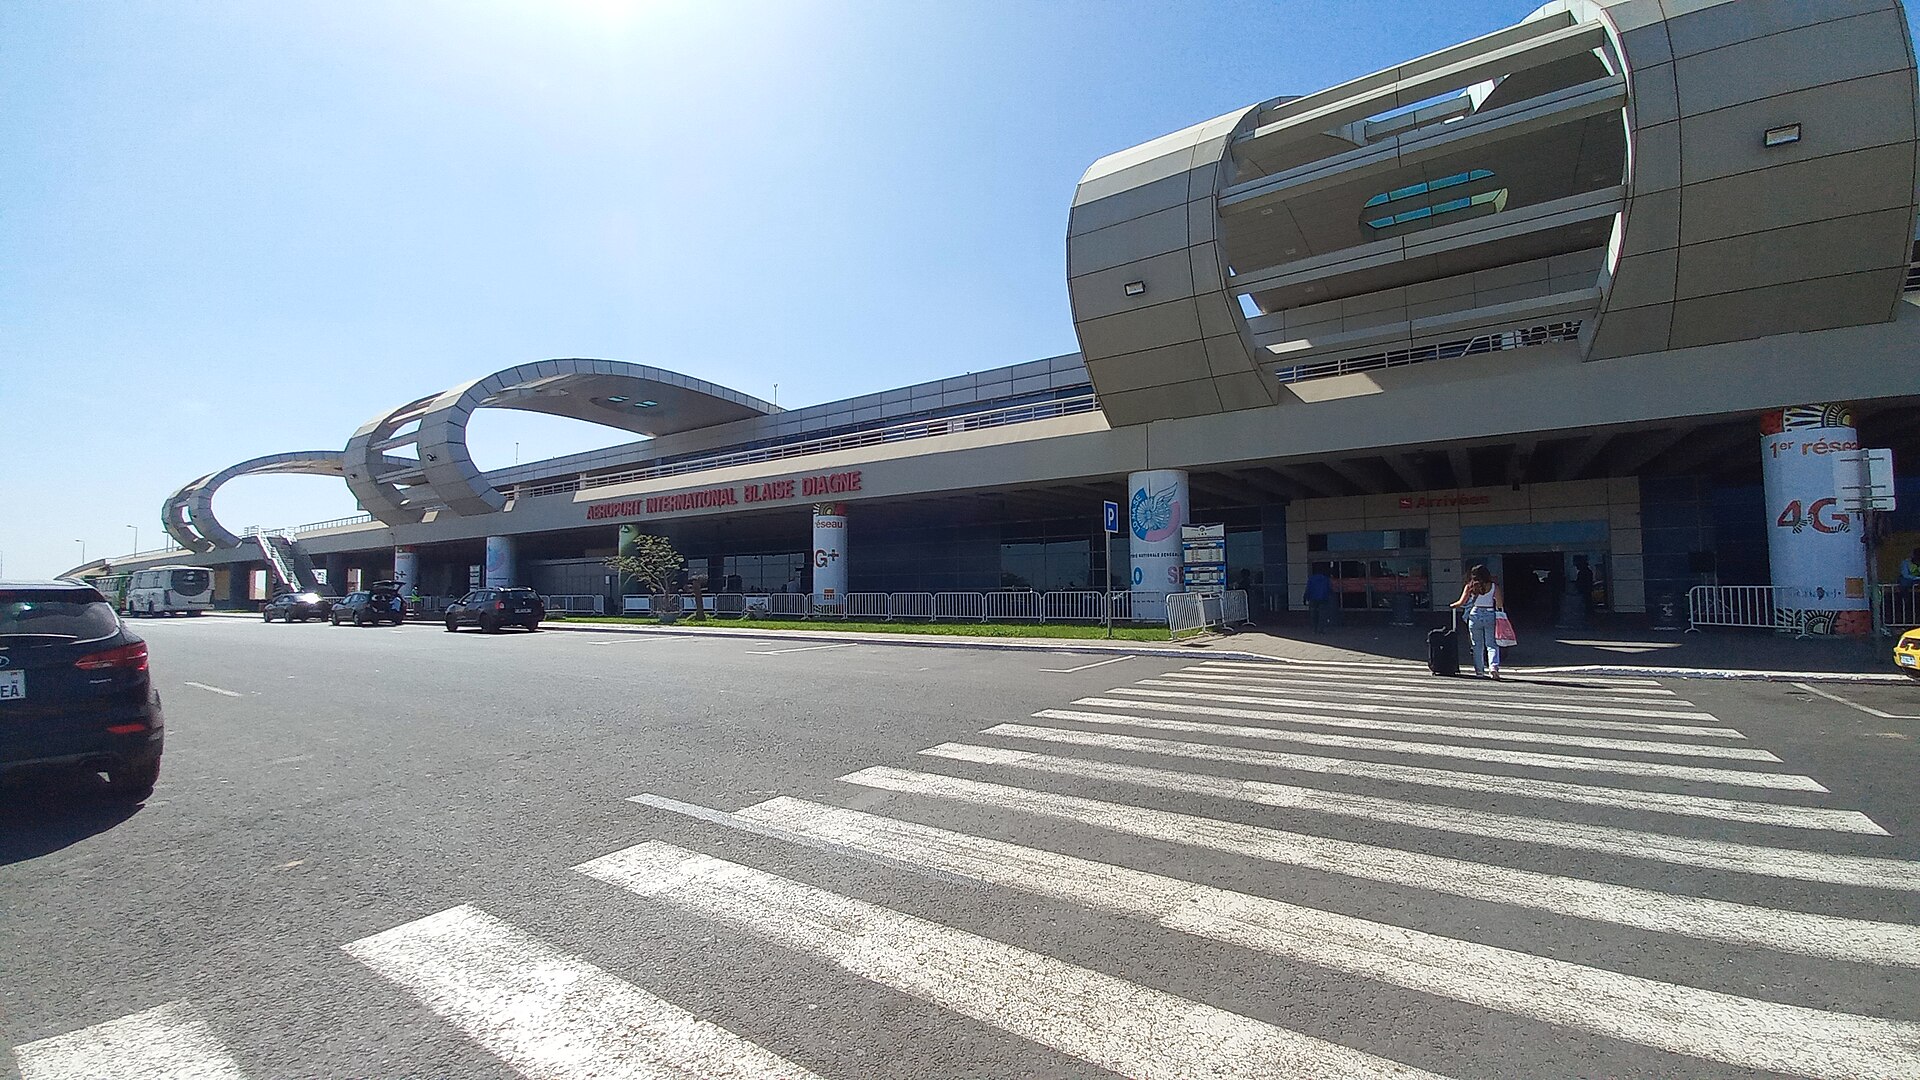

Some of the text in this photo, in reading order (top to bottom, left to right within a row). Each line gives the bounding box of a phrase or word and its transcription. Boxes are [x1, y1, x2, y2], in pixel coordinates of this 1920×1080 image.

[1769, 440, 1795, 458] 1er
[646, 487, 738, 515] INTERNATIONAL
[743, 479, 794, 504] BLAISE
[801, 471, 862, 497] DIAGNE
[1415, 493, 1489, 508] Arrivées
[1108, 508, 1115, 526] P
[1777, 497, 1850, 534] 4G
